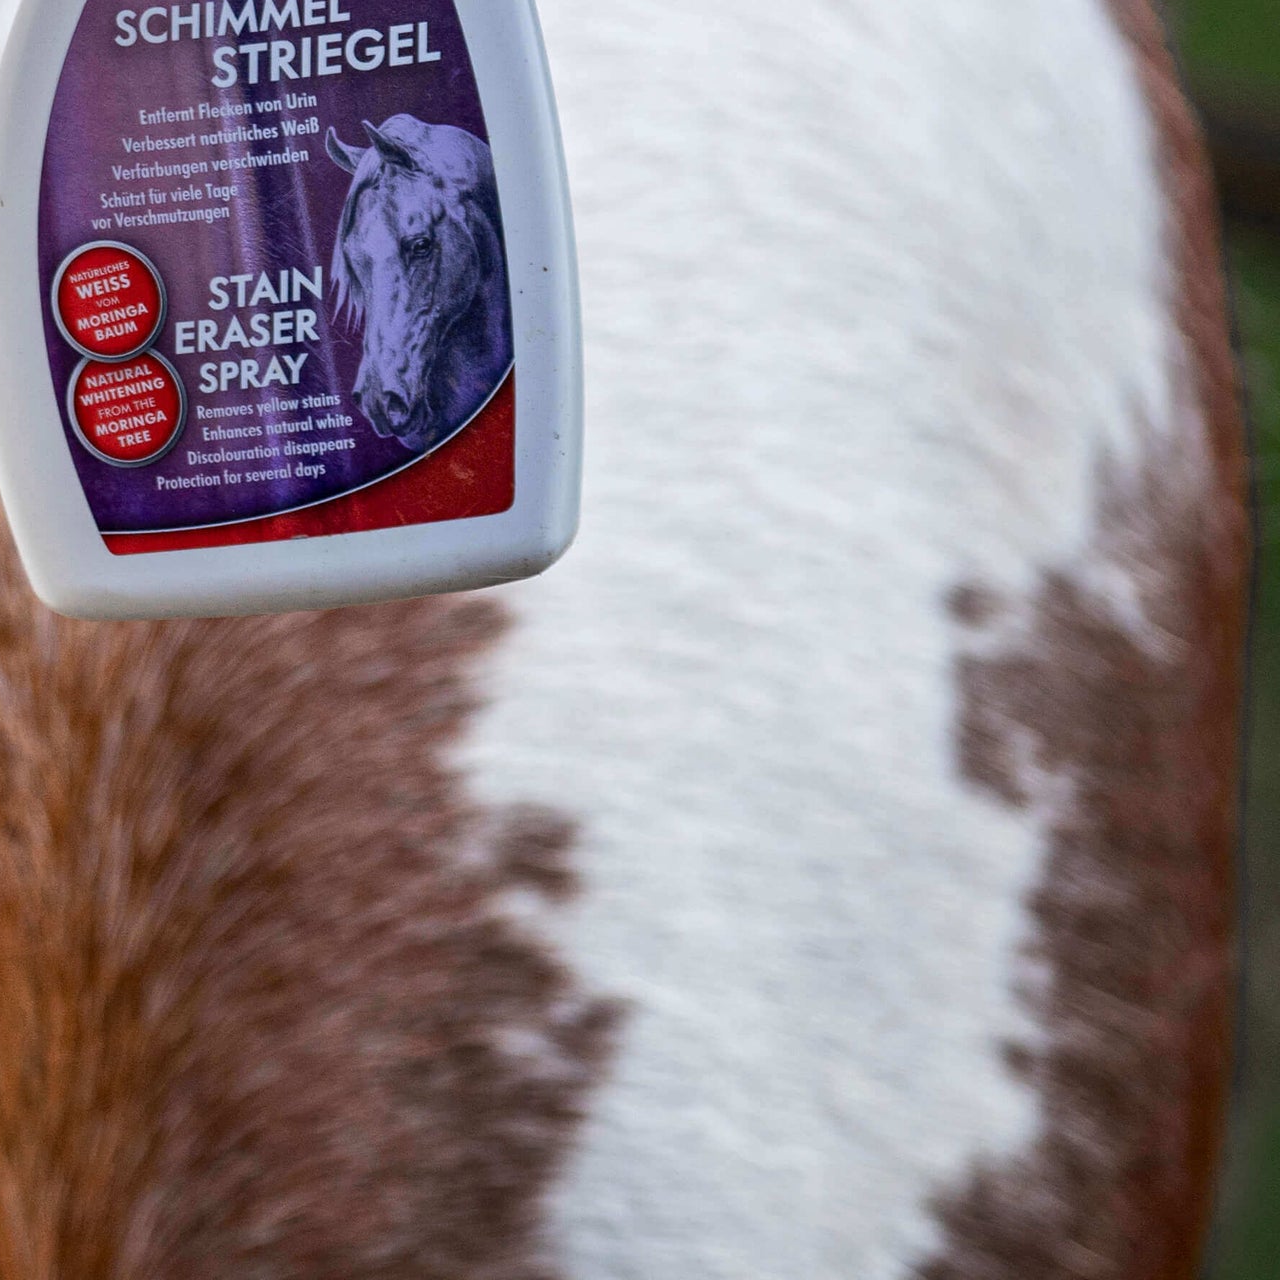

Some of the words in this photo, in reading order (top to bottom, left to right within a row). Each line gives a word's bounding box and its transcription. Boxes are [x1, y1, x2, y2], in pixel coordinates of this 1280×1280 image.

[211, 21, 441, 88] STRIEGEL
[139, 106, 195, 126] Entfernt
[198, 101, 252, 119] Flecken
[256, 99, 283, 114] von
[286, 92, 318, 109] Urin
[122, 133, 197, 153] Verbessert
[200, 124, 279, 146] natürliches
[281, 116, 320, 138] Weiß
[111, 158, 209, 181] Verfärbungen
[211, 147, 309, 171] verschwinden
[100, 191, 146, 209] Schützt
[148, 187, 168, 204] für
[171, 184, 203, 203] viele
[205, 182, 239, 202] Tage
[91, 216, 112, 230] vor
[114, 206, 230, 229] Verschmutzungen
[75, 273, 131, 299] WEISS
[208, 266, 323, 311] STAIN
[95, 296, 120, 308] VOM
[77, 302, 149, 331] MORINGA
[94, 321, 138, 342] BAUM
[175, 308, 320, 355] ERASER
[86, 364, 153, 389] NATURAL
[198, 352, 309, 394] SPRAY
[79, 377, 165, 407] WHITENING
[98, 403, 131, 420] FROM
[133, 397, 157, 411] THE
[196, 404, 254, 421] Removes
[256, 397, 299, 418] yellow
[302, 393, 341, 410] stains
[95, 409, 167, 437] MORINGA
[202, 424, 263, 442] Enhances
[266, 416, 313, 436] natural
[316, 412, 353, 430] white
[117, 429, 152, 448] TREE
[187, 444, 280, 465] Discolouration
[284, 435, 356, 457] disappears
[157, 473, 221, 490] Protection
[224, 468, 242, 484] for
[245, 464, 292, 483] several
[295, 462, 326, 478] days
